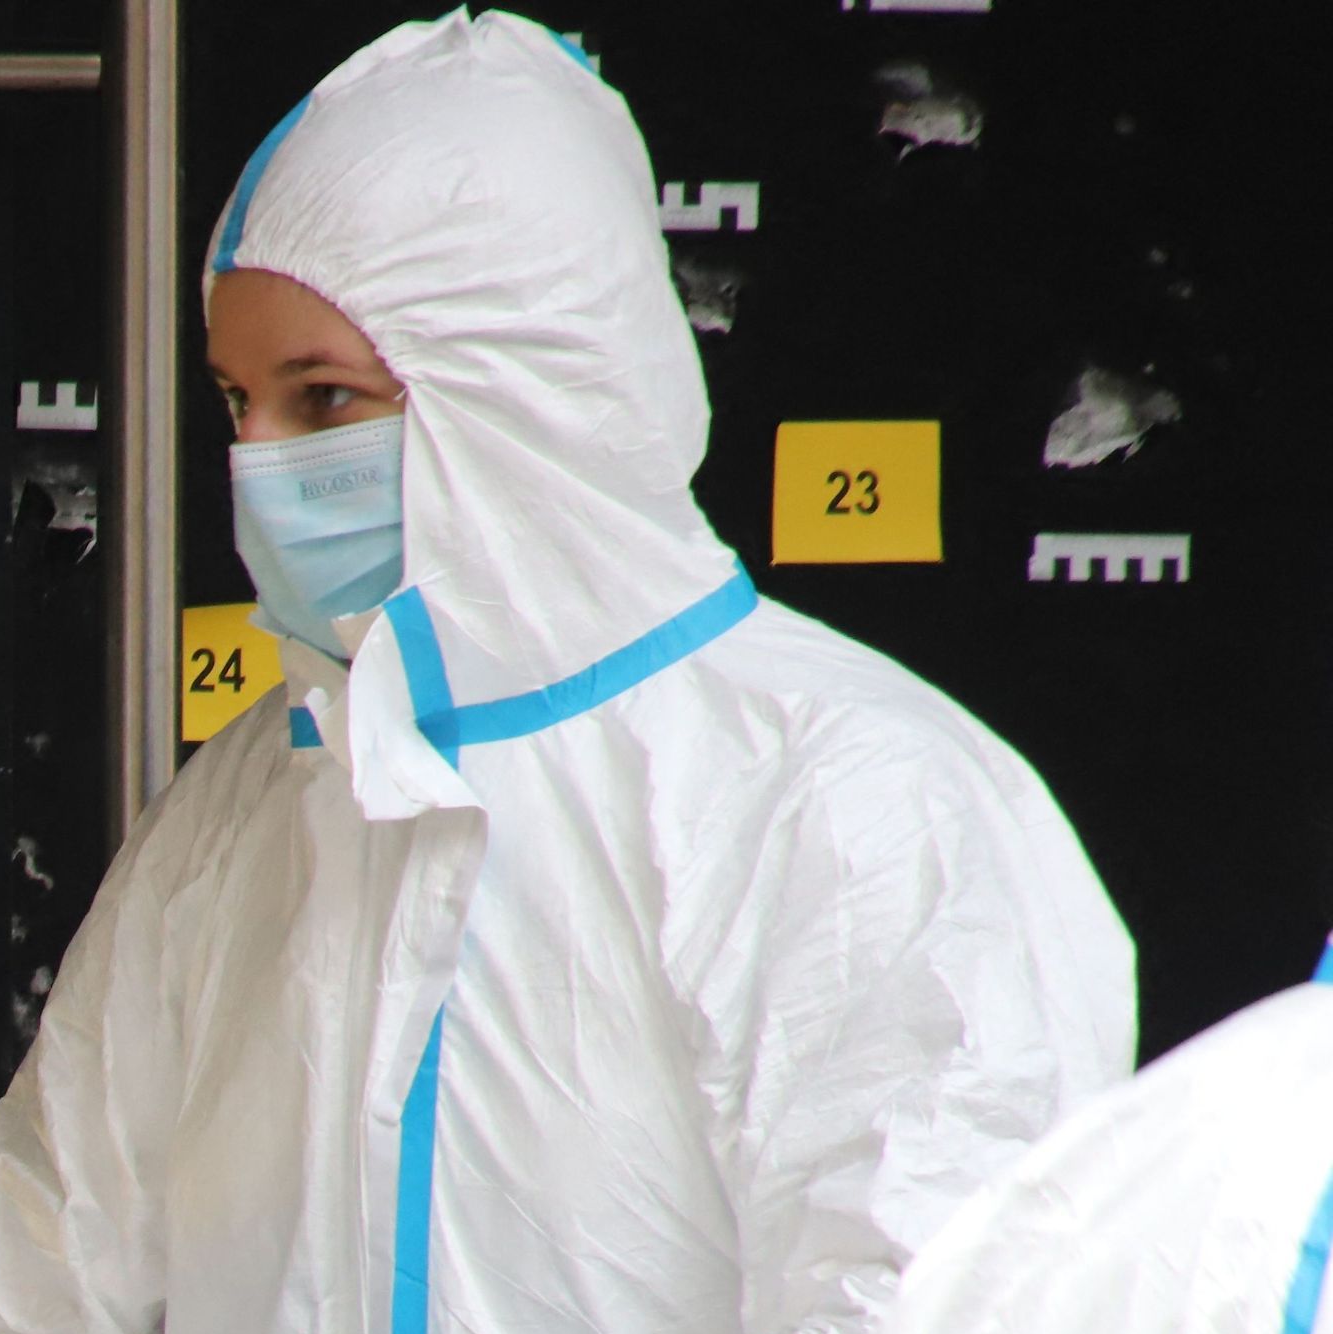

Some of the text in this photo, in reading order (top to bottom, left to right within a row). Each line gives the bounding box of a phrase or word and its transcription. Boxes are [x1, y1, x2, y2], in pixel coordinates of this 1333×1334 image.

[300, 467, 381, 500] HYGOSTAR
[825, 470, 880, 514] 23
[189, 647, 245, 692] 24
